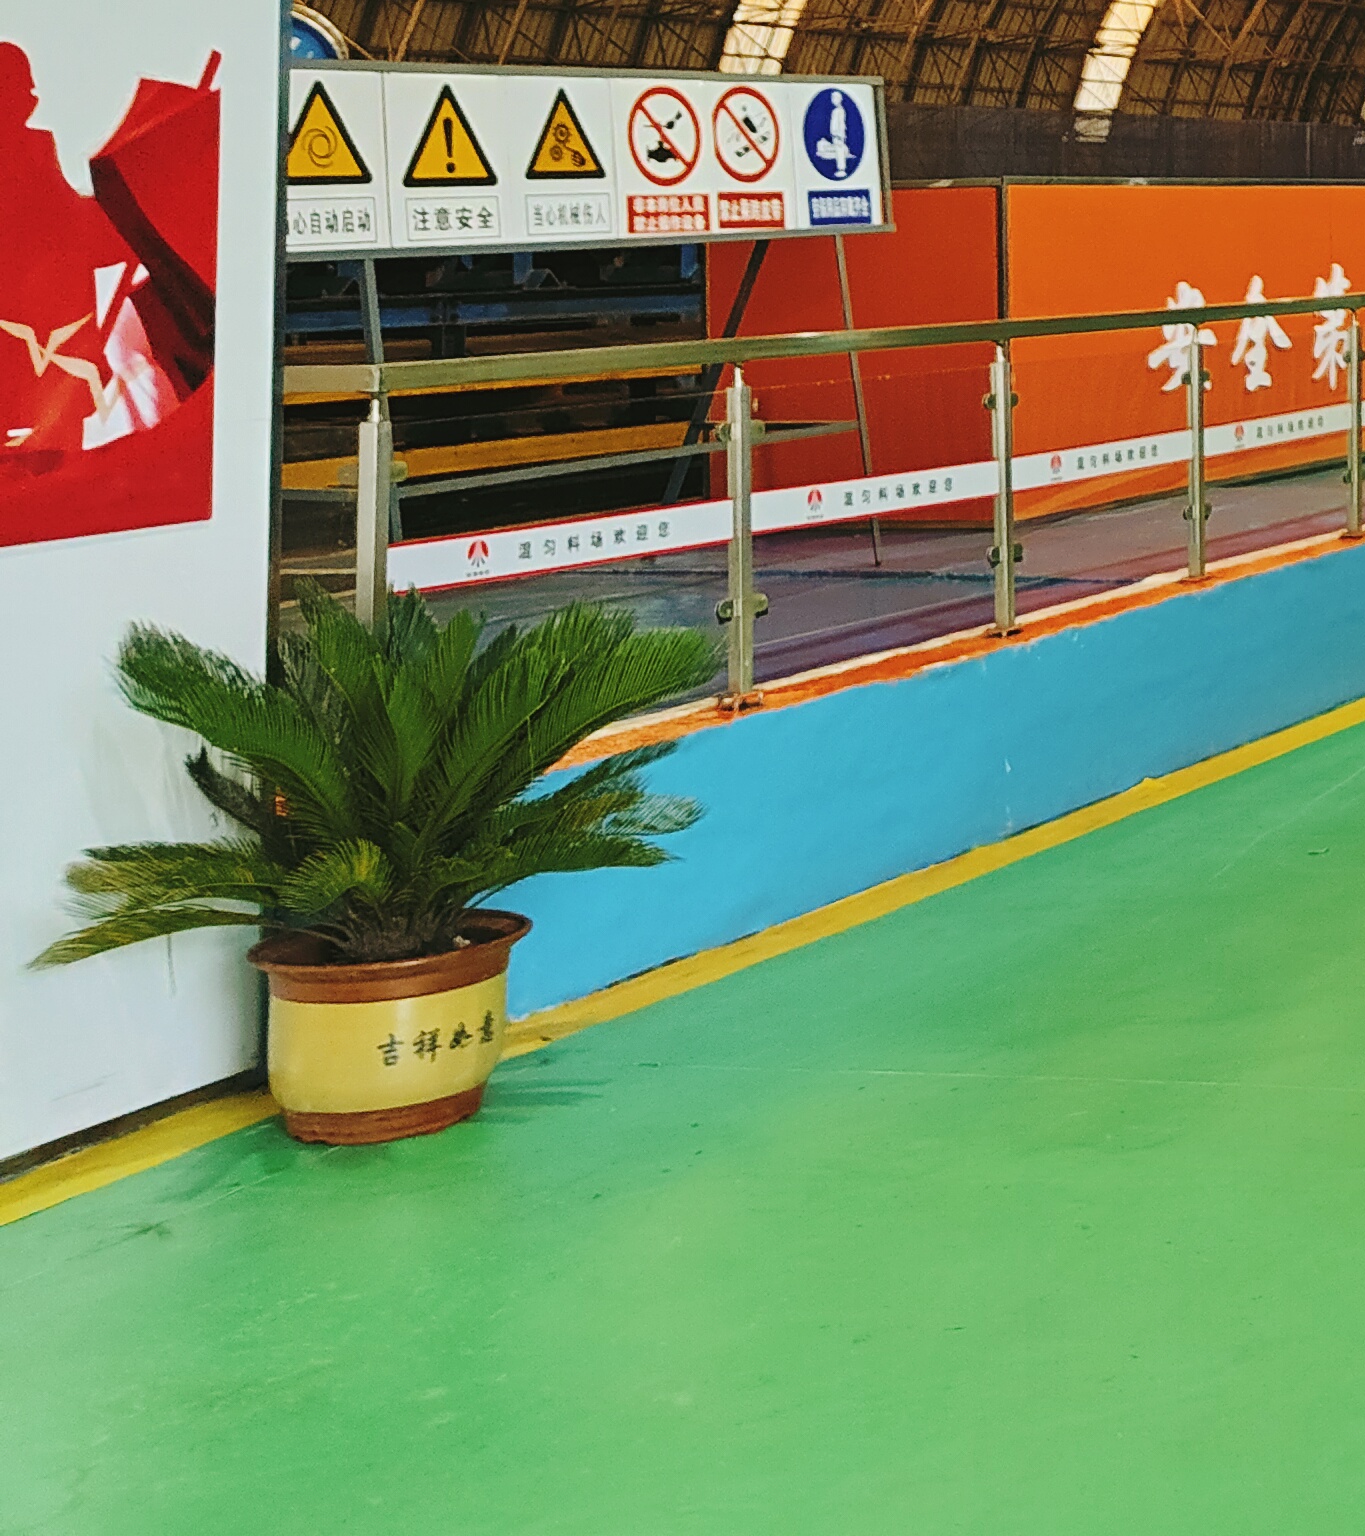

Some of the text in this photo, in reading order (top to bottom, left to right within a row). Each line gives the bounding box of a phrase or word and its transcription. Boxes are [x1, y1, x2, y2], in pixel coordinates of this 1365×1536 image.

[287, 207, 371, 236] 心自动启动
[413, 205, 495, 232] 注意安全
[533, 201, 607, 227] 当心机械伤人
